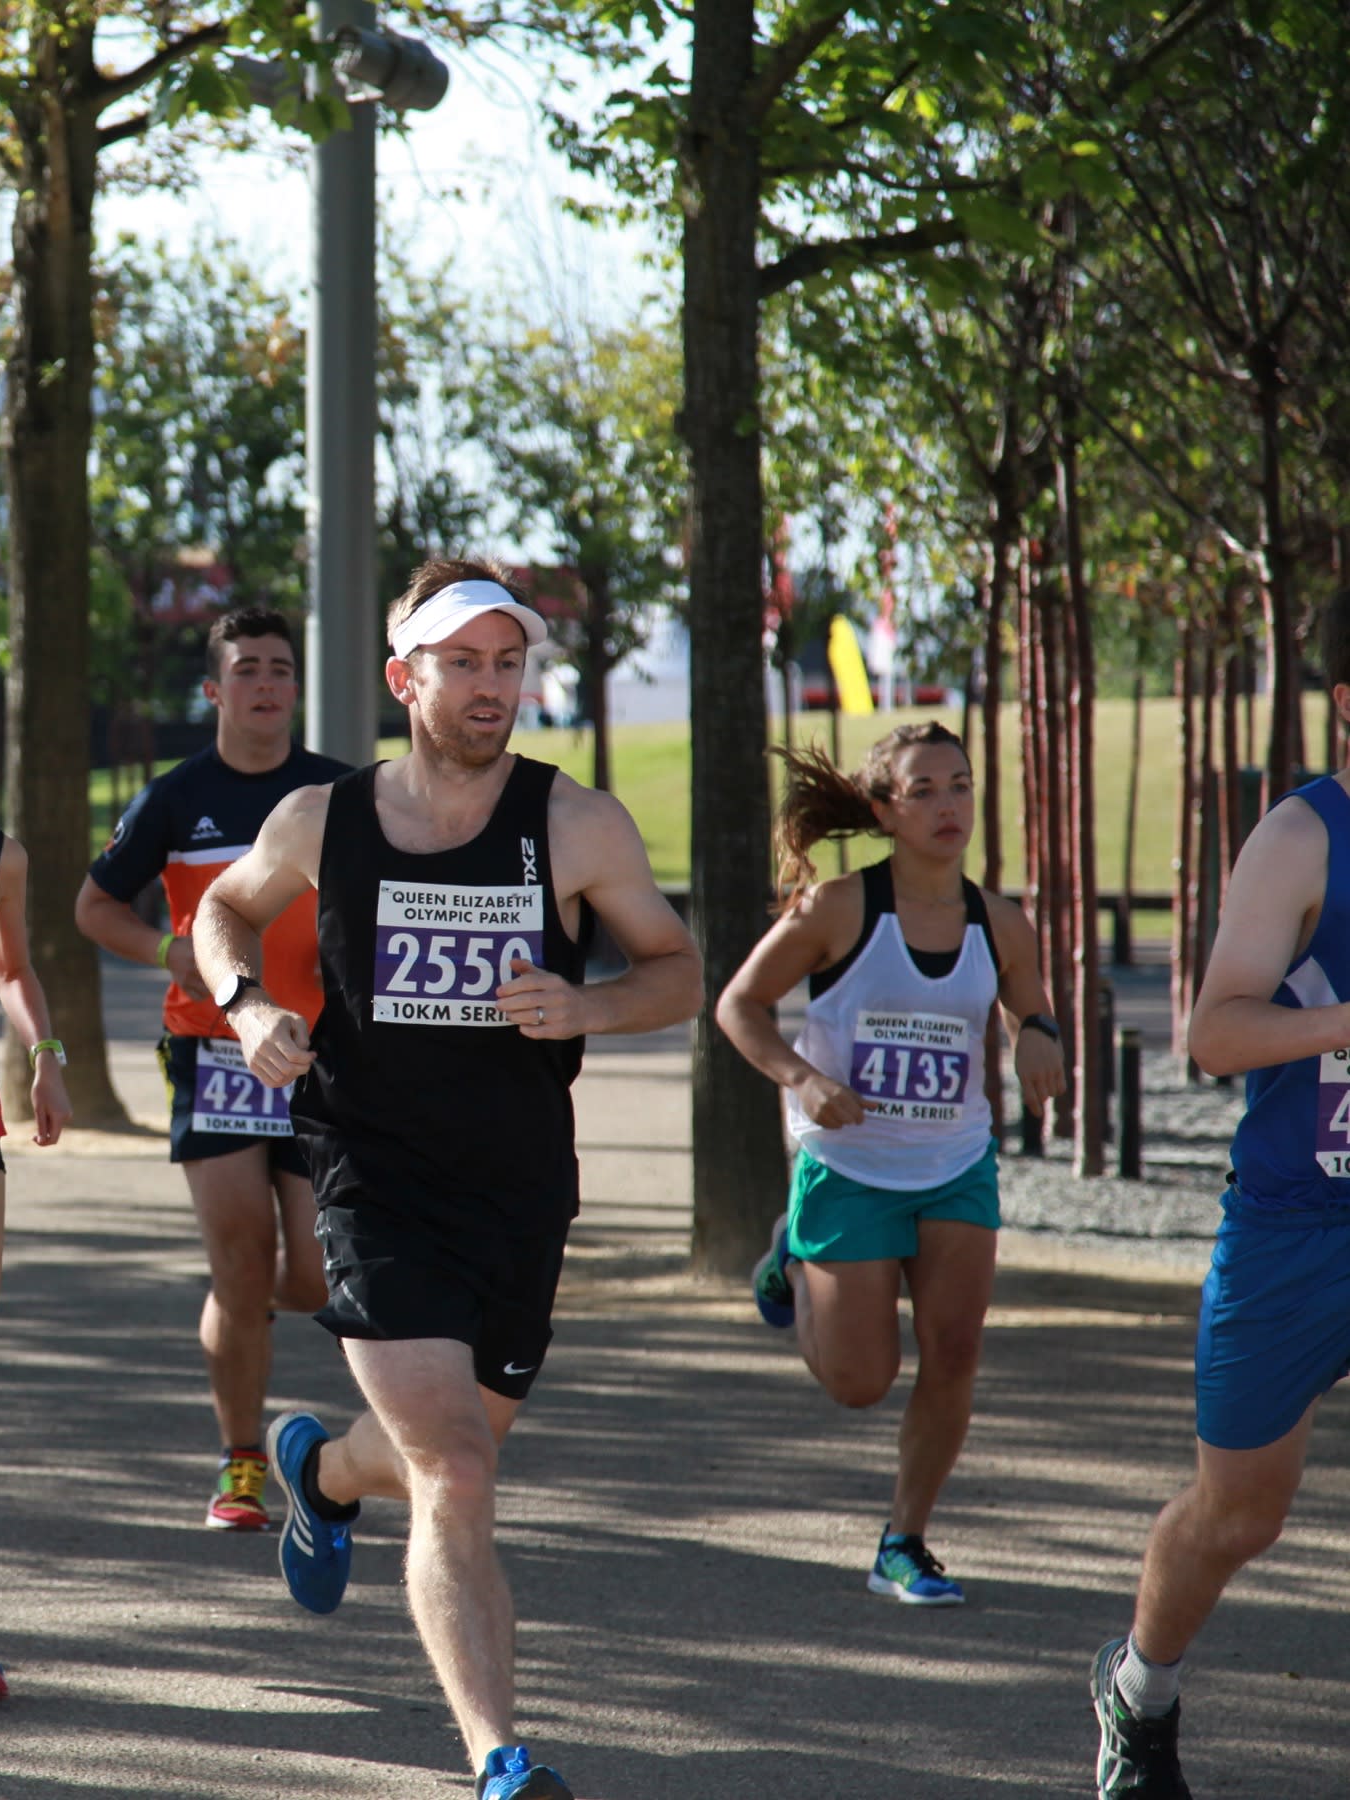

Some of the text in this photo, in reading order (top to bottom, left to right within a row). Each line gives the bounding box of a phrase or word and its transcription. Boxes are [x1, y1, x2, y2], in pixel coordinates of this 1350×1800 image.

[392, 890, 533, 908] QUEEN ELIZABETH
[404, 907, 522, 925] OLYMPIC PARK
[385, 932, 533, 997] 2550
[392, 1002, 508, 1022] 10KM SERI
[867, 1017, 963, 1035] QUEEN ELIZABETH
[875, 1029, 953, 1045] OLYMPIC PARK
[858, 1047, 962, 1101] 4135
[911, 1104, 956, 1120] SERIES
[206, 1117, 291, 1133] 10KM SERIE
